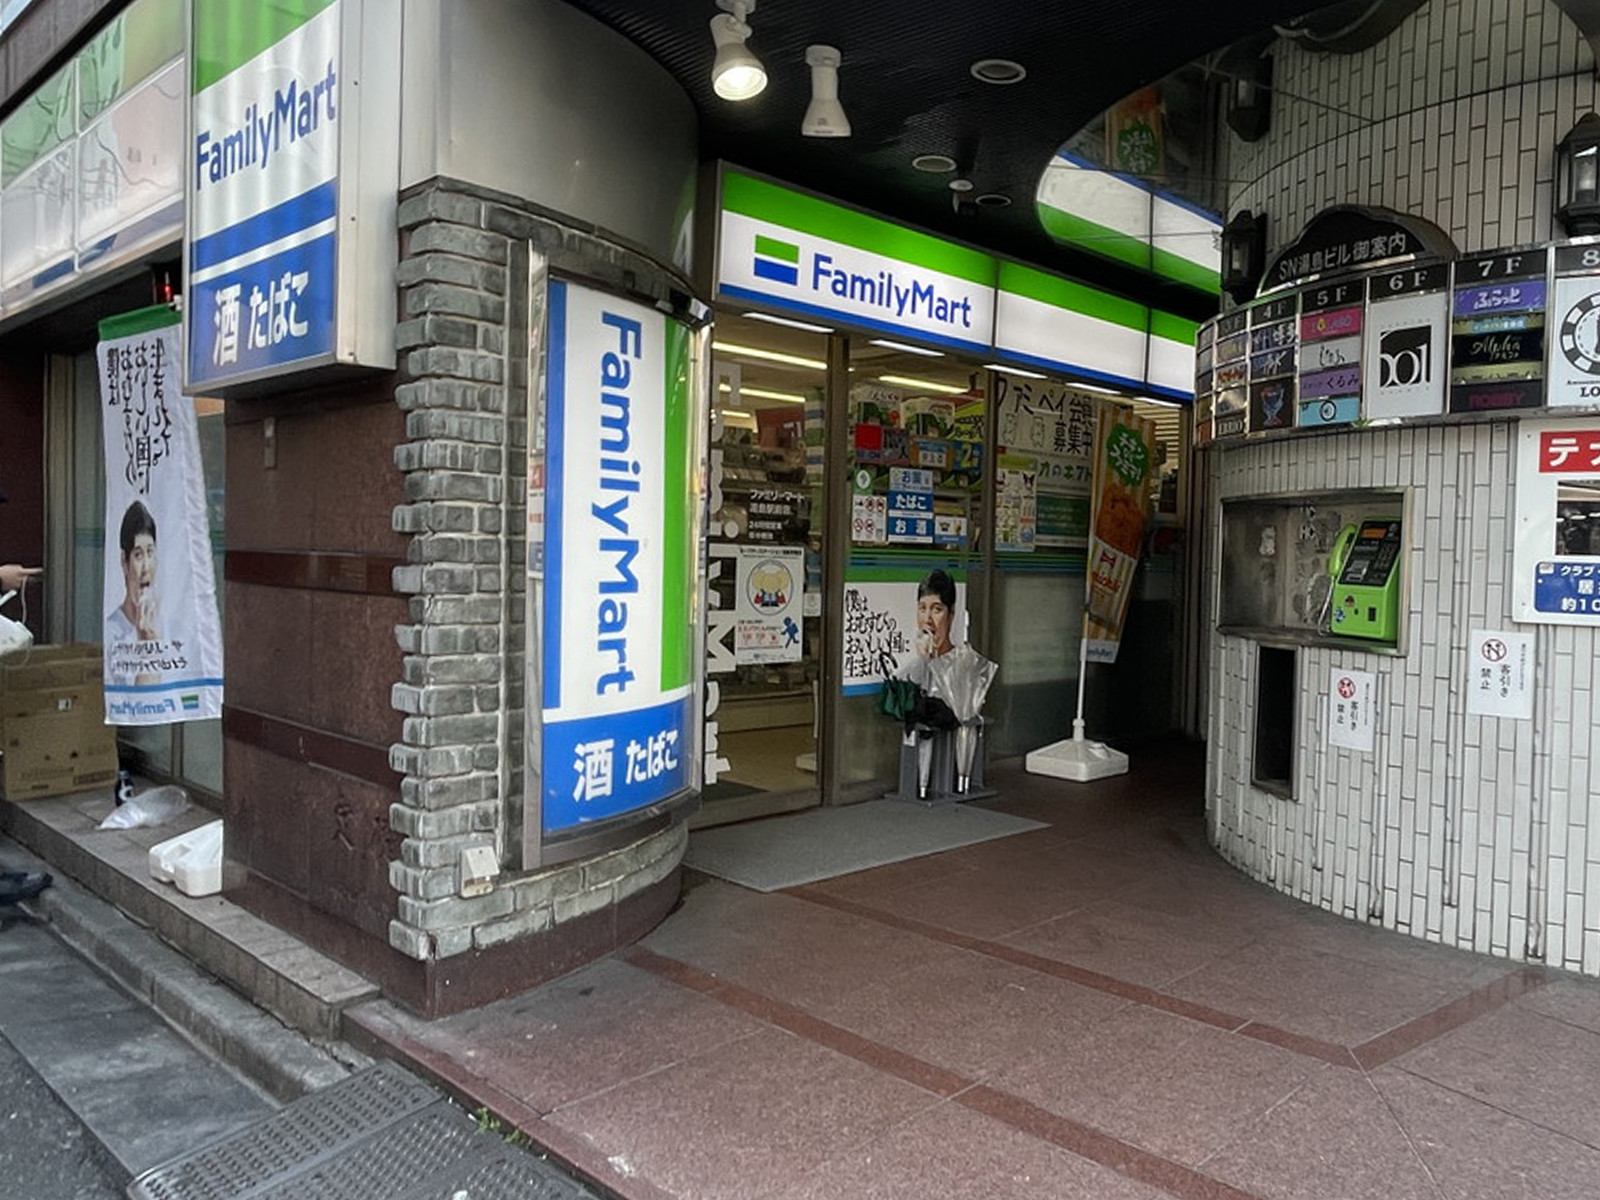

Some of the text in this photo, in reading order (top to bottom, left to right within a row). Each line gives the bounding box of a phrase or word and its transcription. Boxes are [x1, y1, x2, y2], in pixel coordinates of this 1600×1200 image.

[196, 58, 338, 191] FamilyMart
[213, 270, 311, 366] 酒 たばこ
[811, 252, 972, 328] FamilyMart
[589, 310, 642, 697] FamilyMart
[749, 489, 805, 503] ファミリーマート
[895, 493, 928, 510] たばこ
[572, 728, 680, 803] 酒 たばこ
